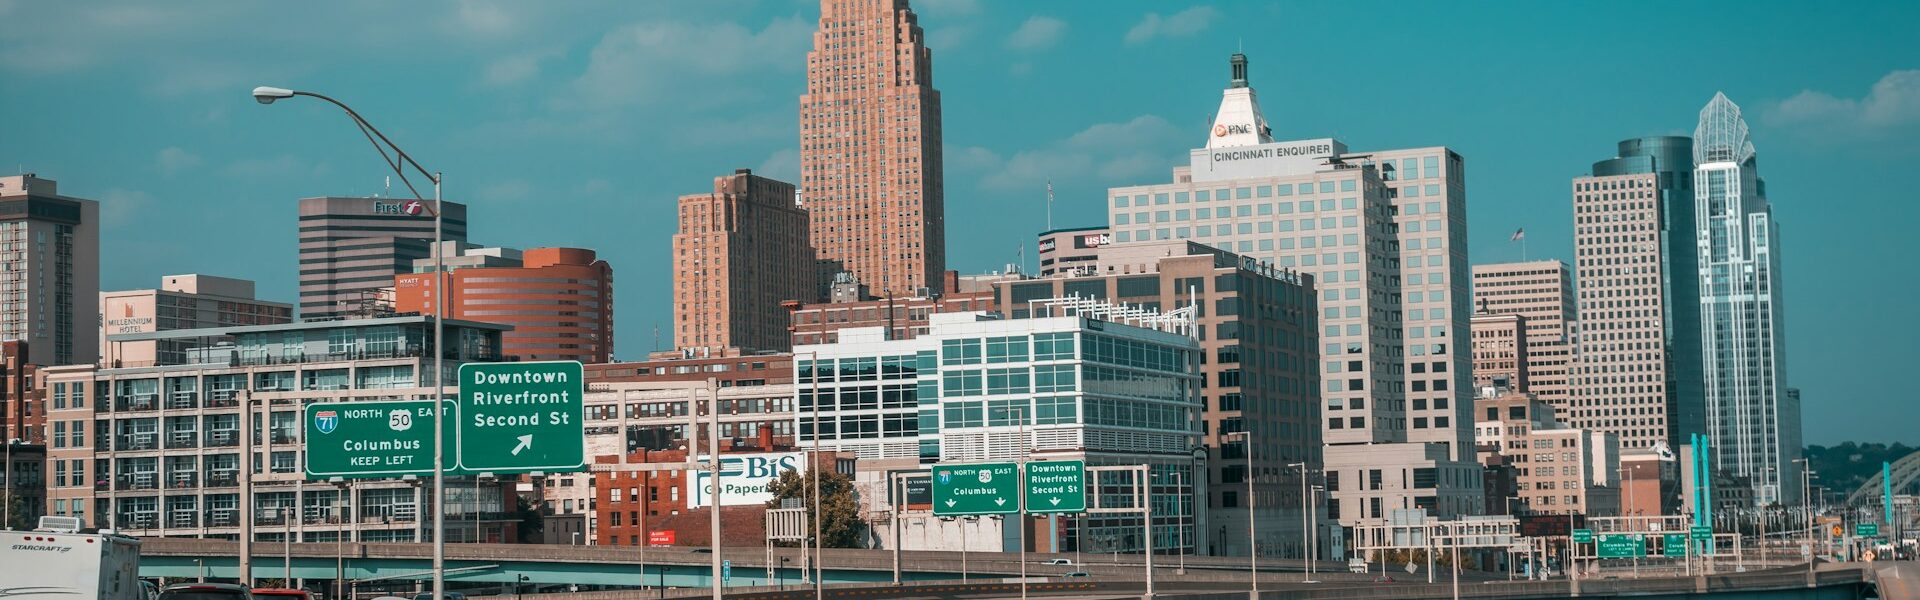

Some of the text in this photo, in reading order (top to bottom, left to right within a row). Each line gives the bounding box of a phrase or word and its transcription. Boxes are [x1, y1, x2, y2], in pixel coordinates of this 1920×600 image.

[1228, 123, 1252, 135] PNC
[1214, 144, 1331, 162] CINCINNATI ENQUIRER
[374, 201, 404, 214] First
[1085, 234, 1110, 246] usb
[108, 317, 153, 326] MILLENNIUM
[119, 325, 142, 333] HOTEL
[474, 371, 568, 385] Downtown
[473, 390, 569, 406] Riverfront
[319, 407, 448, 431] 71 NORTH 50 EAT
[474, 411, 569, 428] Second St
[343, 439, 421, 451] Columbus
[350, 455, 414, 466] KEEP LEFT
[941, 474, 949, 482] 71
[980, 472, 991, 480] 50
[994, 467, 1012, 475] EAST
[1031, 464, 1077, 473] Downtown
[1031, 474, 1078, 483] Riverfront
[953, 487, 997, 495] Columbus
[1031, 484, 1078, 494] Second St
[12, 544, 62, 553] STARCRAFT
